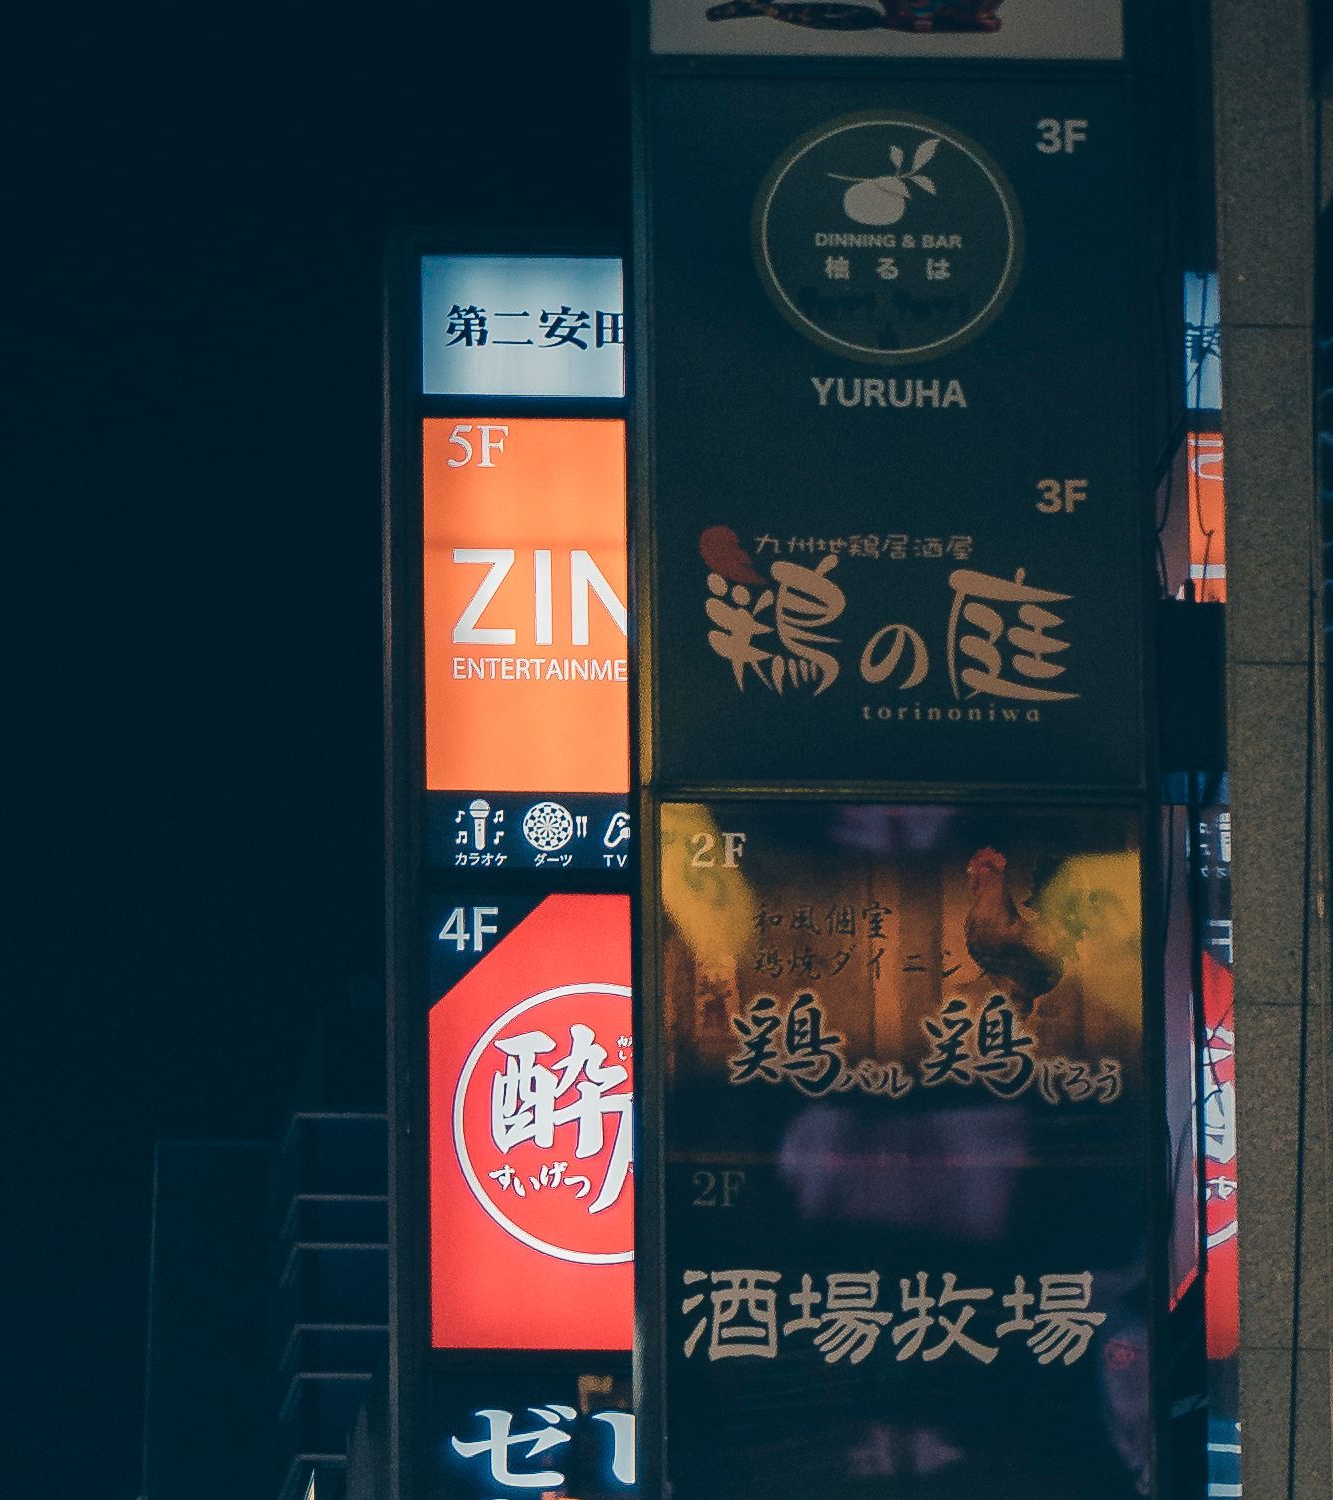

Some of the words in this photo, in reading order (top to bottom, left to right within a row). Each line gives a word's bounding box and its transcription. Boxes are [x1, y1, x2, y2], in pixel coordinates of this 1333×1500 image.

[1037, 119, 1088, 153] 3F
[815, 233, 896, 249] DINNING
[902, 233, 917, 249] &
[922, 233, 962, 249] BAR
[825, 256, 950, 282] 柚るは
[811, 377, 967, 409] YURUHA
[447, 425, 508, 469] 5F
[1037, 480, 1088, 513] 3F
[705, 553, 1083, 697] 鶏の庭
[863, 704, 1041, 722] torinoniwa
[454, 851, 507, 867] カラオケ
[533, 851, 573, 868] ダーツ
[690, 832, 746, 869] 2F
[438, 907, 499, 951] 4F
[754, 902, 892, 940] 和風個室
[489, 1163, 591, 1198] すいげつ
[692, 1171, 746, 1207] 2F
[681, 1269, 1107, 1364] 酒場牧場
